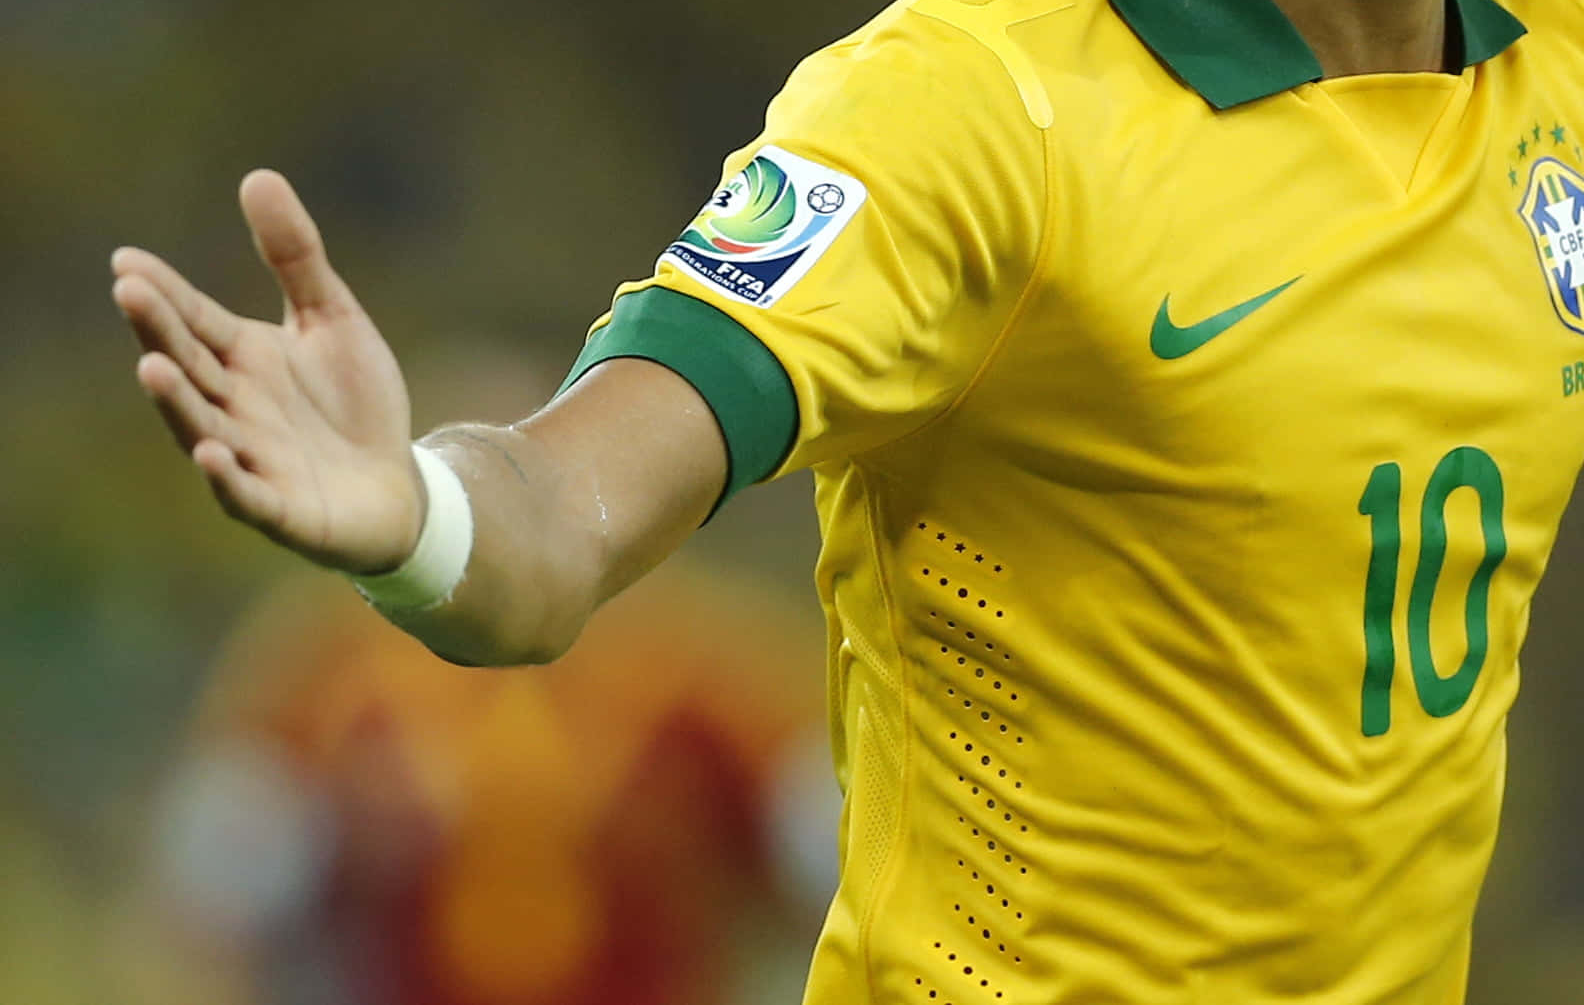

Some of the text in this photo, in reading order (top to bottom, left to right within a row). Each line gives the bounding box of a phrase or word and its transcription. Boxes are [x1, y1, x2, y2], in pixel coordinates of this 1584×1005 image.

[1559, 230, 1584, 255] CBF
[716, 262, 765, 295] FIFA
[737, 286, 758, 299] CUP
[1358, 446, 1507, 737] 10
